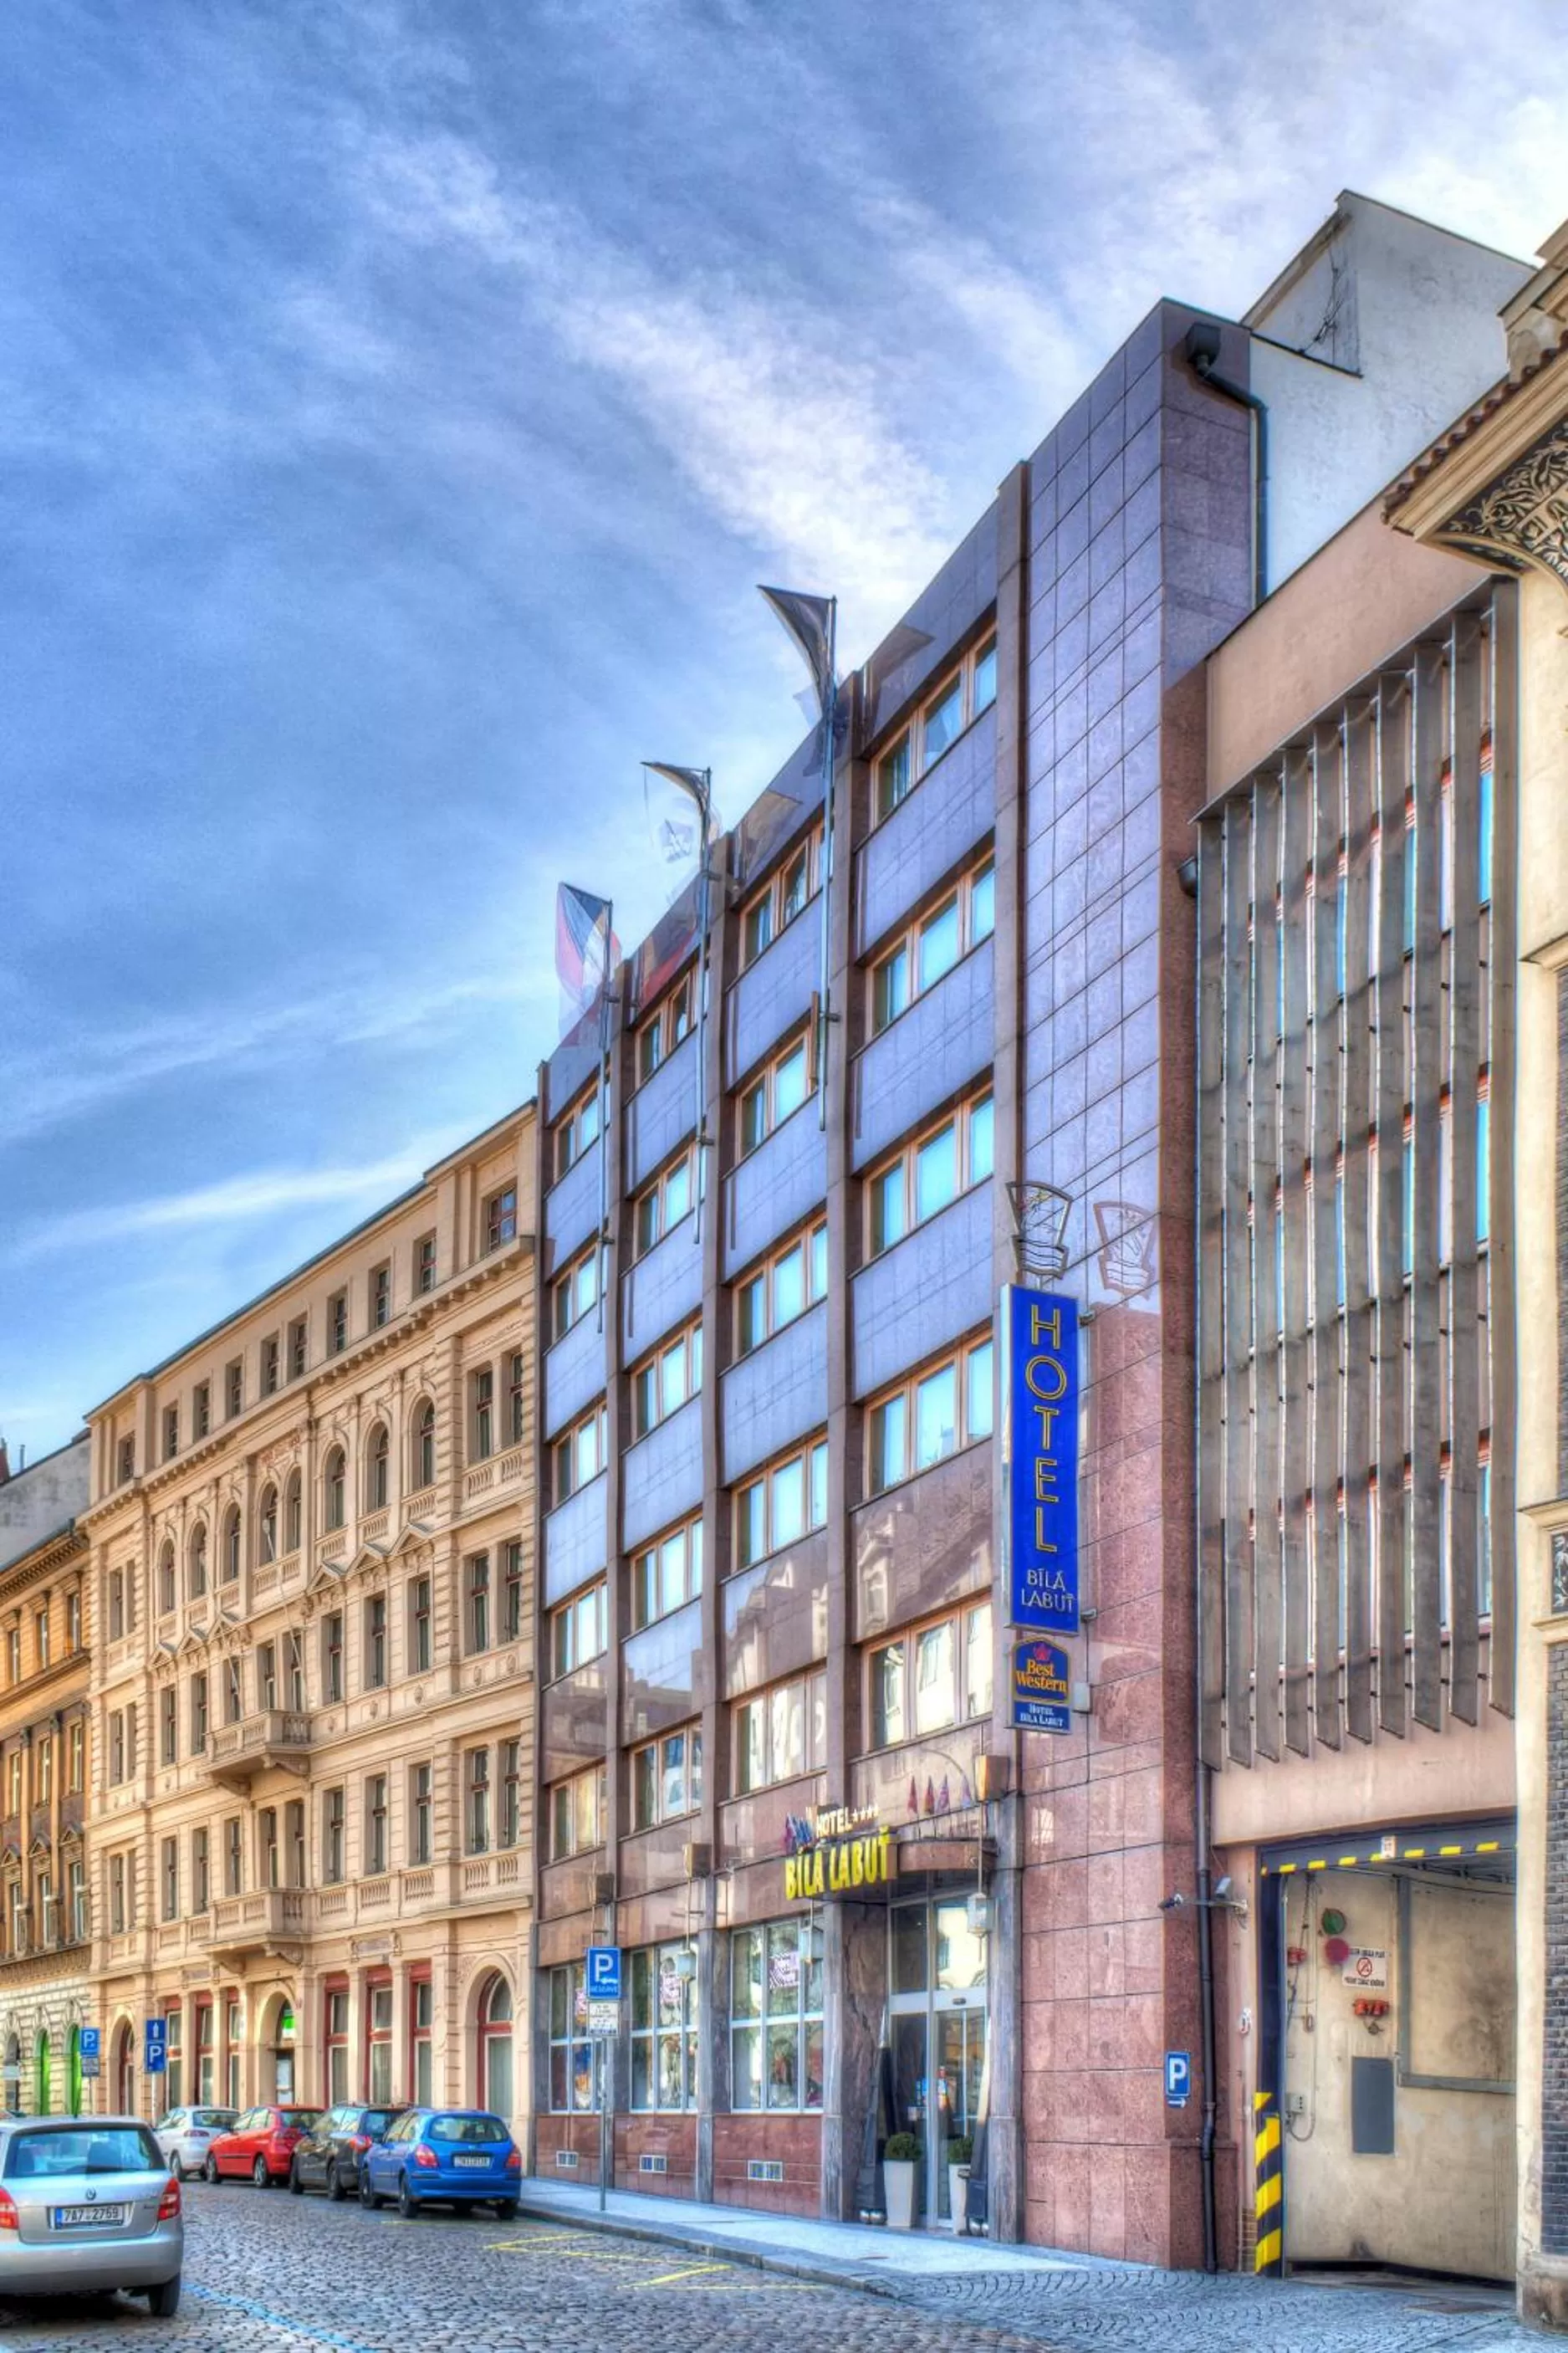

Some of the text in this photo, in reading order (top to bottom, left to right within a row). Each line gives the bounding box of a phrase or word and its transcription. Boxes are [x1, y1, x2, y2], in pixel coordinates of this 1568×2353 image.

[1025, 1304, 1067, 1552] HOTEL
[1027, 1659, 1055, 1677] Best
[1016, 1670, 1067, 1693] Western
[816, 1807, 852, 1839] HOTEL
[595, 1954, 614, 1982] P
[84, 2031, 95, 2049] P
[151, 2045, 161, 2064] P
[1169, 2058, 1186, 2090] P
